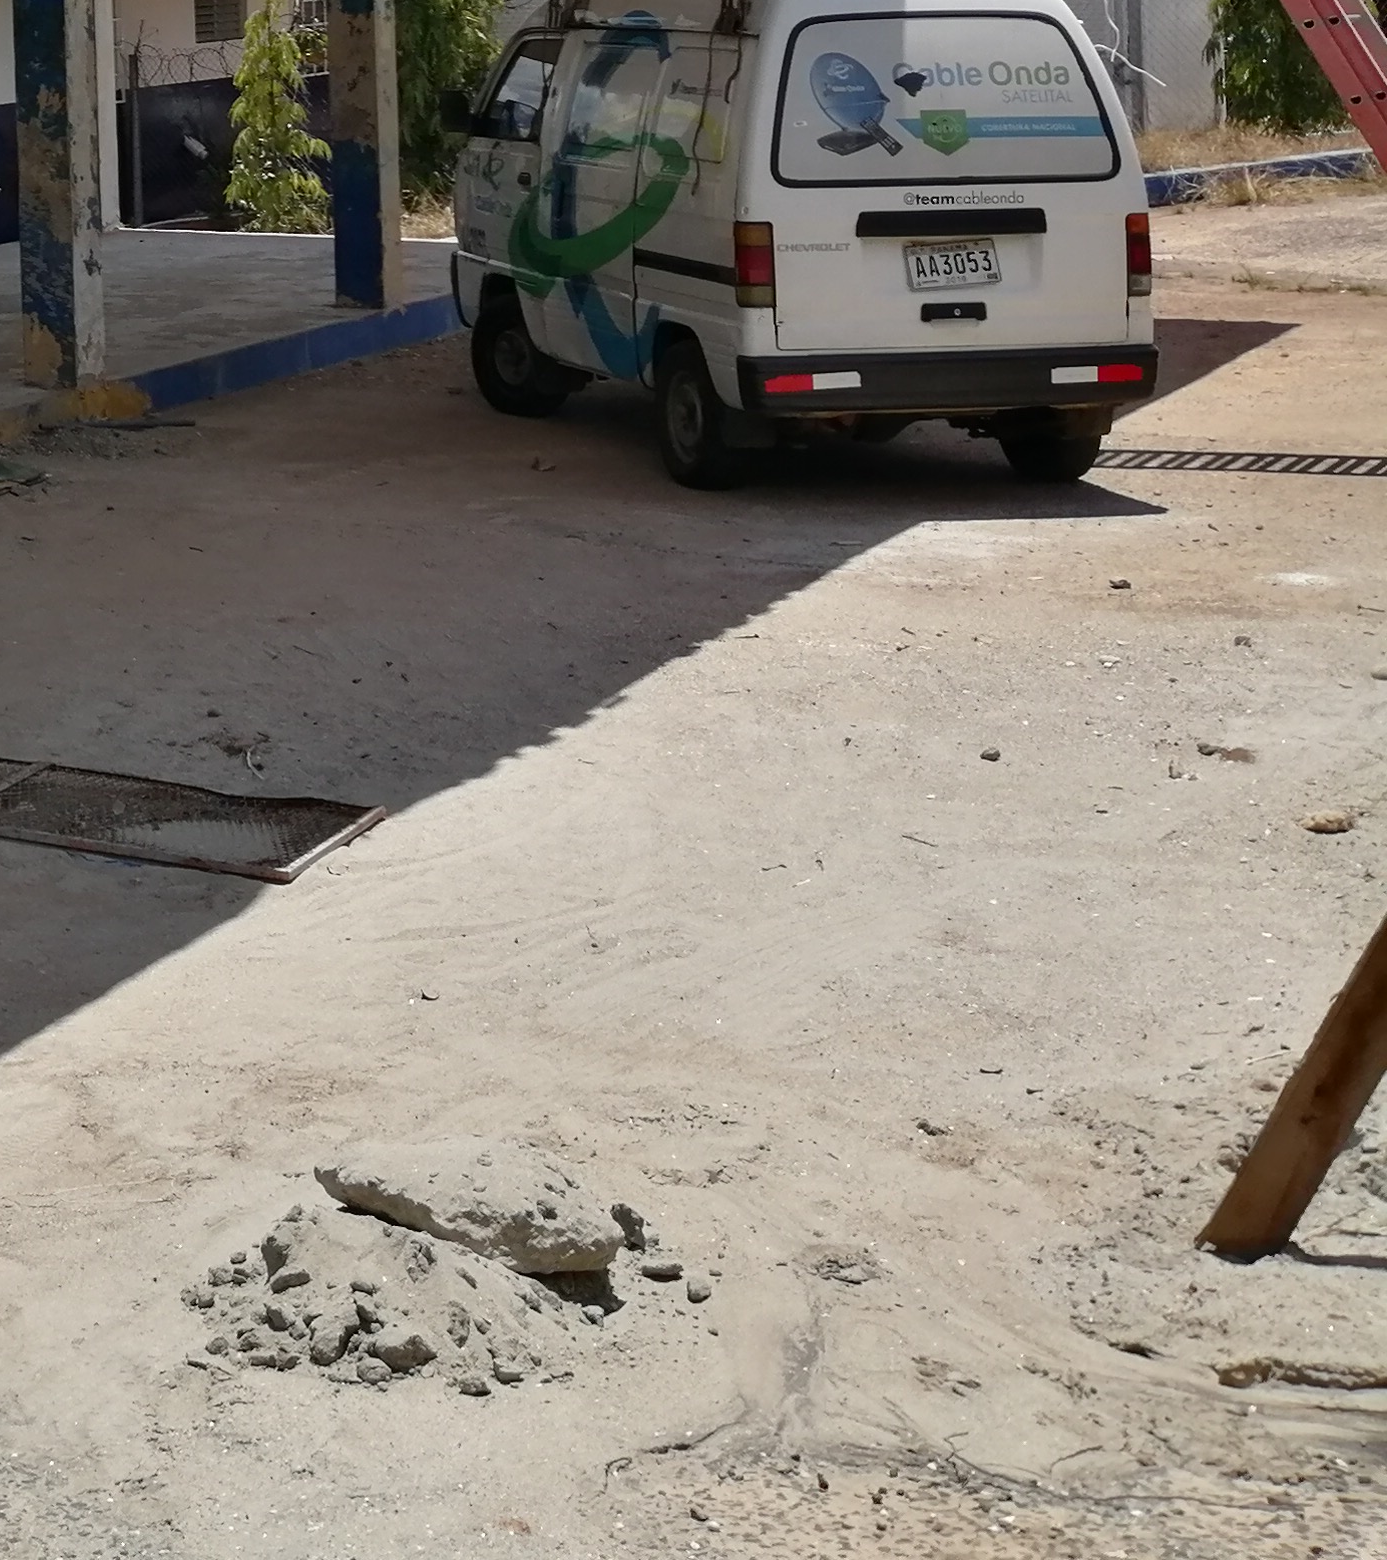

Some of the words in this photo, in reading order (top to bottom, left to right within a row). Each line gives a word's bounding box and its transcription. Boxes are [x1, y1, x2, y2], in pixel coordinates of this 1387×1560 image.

[987, 60, 1070, 86] Onda
[1001, 89, 1074, 104] SATELITAL
[903, 191, 1025, 206] @teamcableonda
[777, 242, 851, 253] CHEVROLET
[915, 250, 992, 278] AA3053
